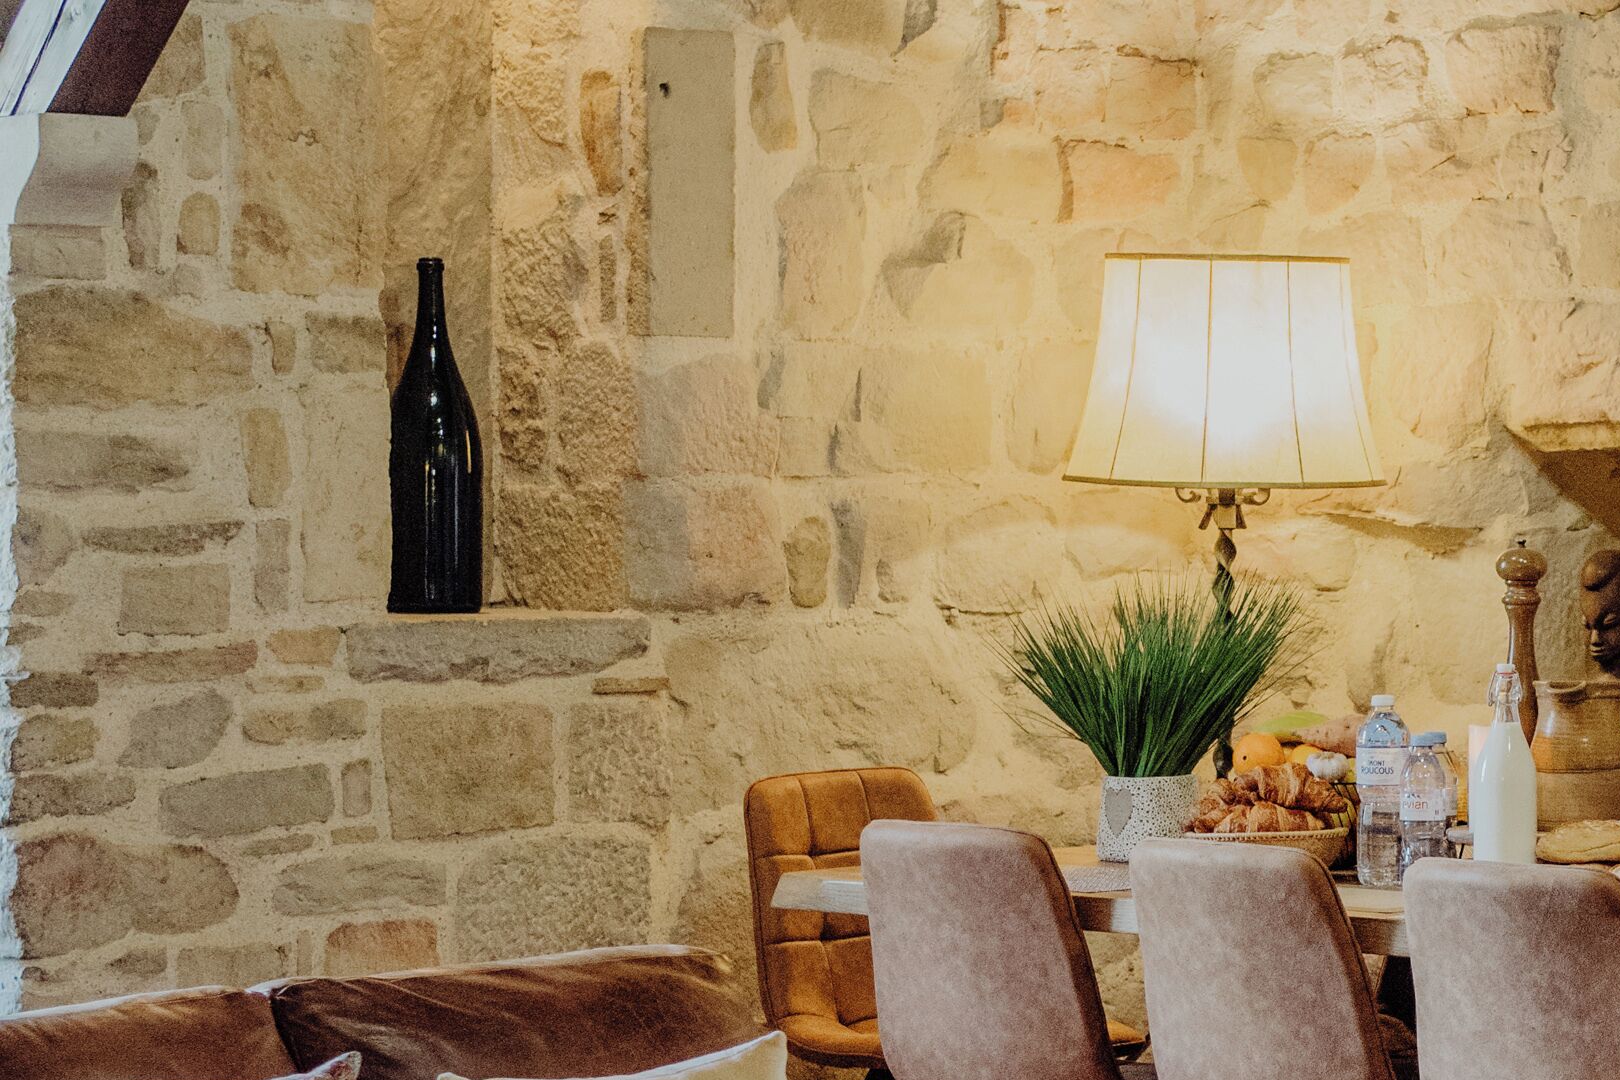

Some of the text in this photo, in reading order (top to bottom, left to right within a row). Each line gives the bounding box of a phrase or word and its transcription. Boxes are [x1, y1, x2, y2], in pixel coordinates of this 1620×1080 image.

[1368, 759, 1385, 767] MONT
[1361, 767, 1394, 775] ROUCOUS
[1402, 800, 1429, 810] evian
